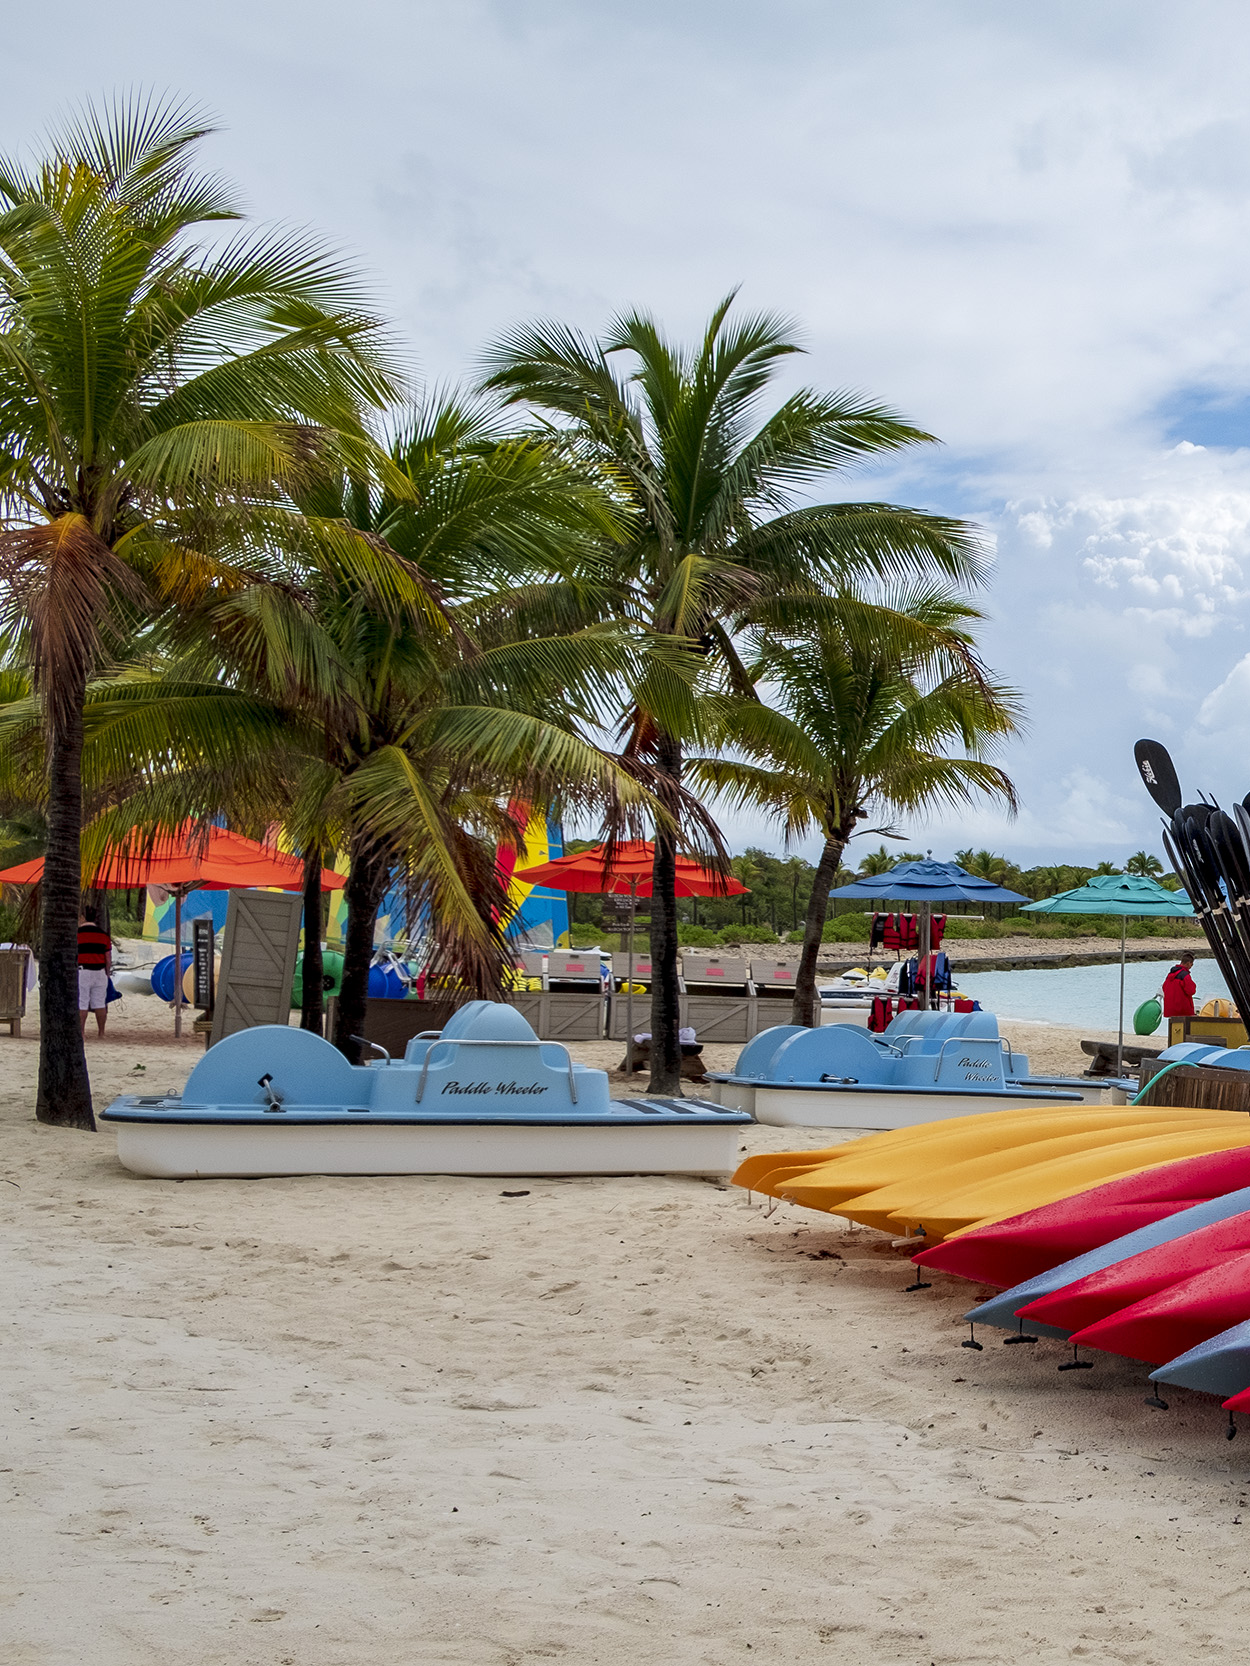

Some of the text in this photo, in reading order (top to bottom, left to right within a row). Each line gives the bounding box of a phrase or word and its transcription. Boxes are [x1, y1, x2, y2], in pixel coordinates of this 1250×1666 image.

[957, 1057, 991, 1068] Paddle
[964, 1071, 999, 1082] Wheeler
[441, 1081, 549, 1095] Paddle Wheeler
